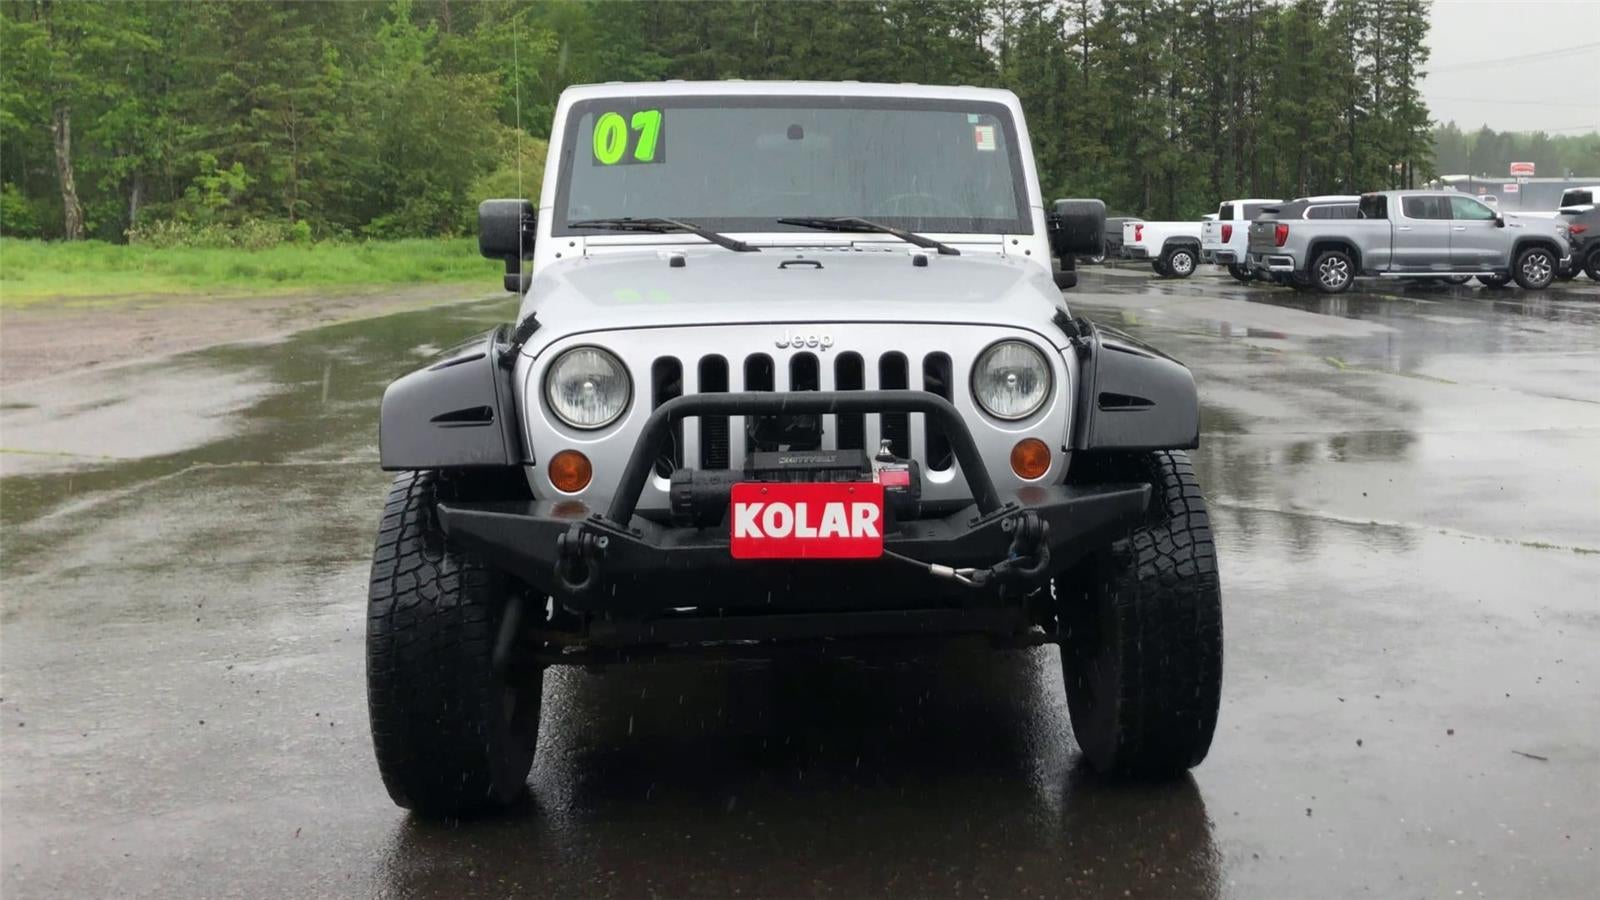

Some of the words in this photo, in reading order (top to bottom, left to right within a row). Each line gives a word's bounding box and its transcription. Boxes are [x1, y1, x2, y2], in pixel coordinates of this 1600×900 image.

[593, 110, 661, 165] 07
[775, 329, 834, 351] Jeep
[734, 502, 880, 538] KOLAR
